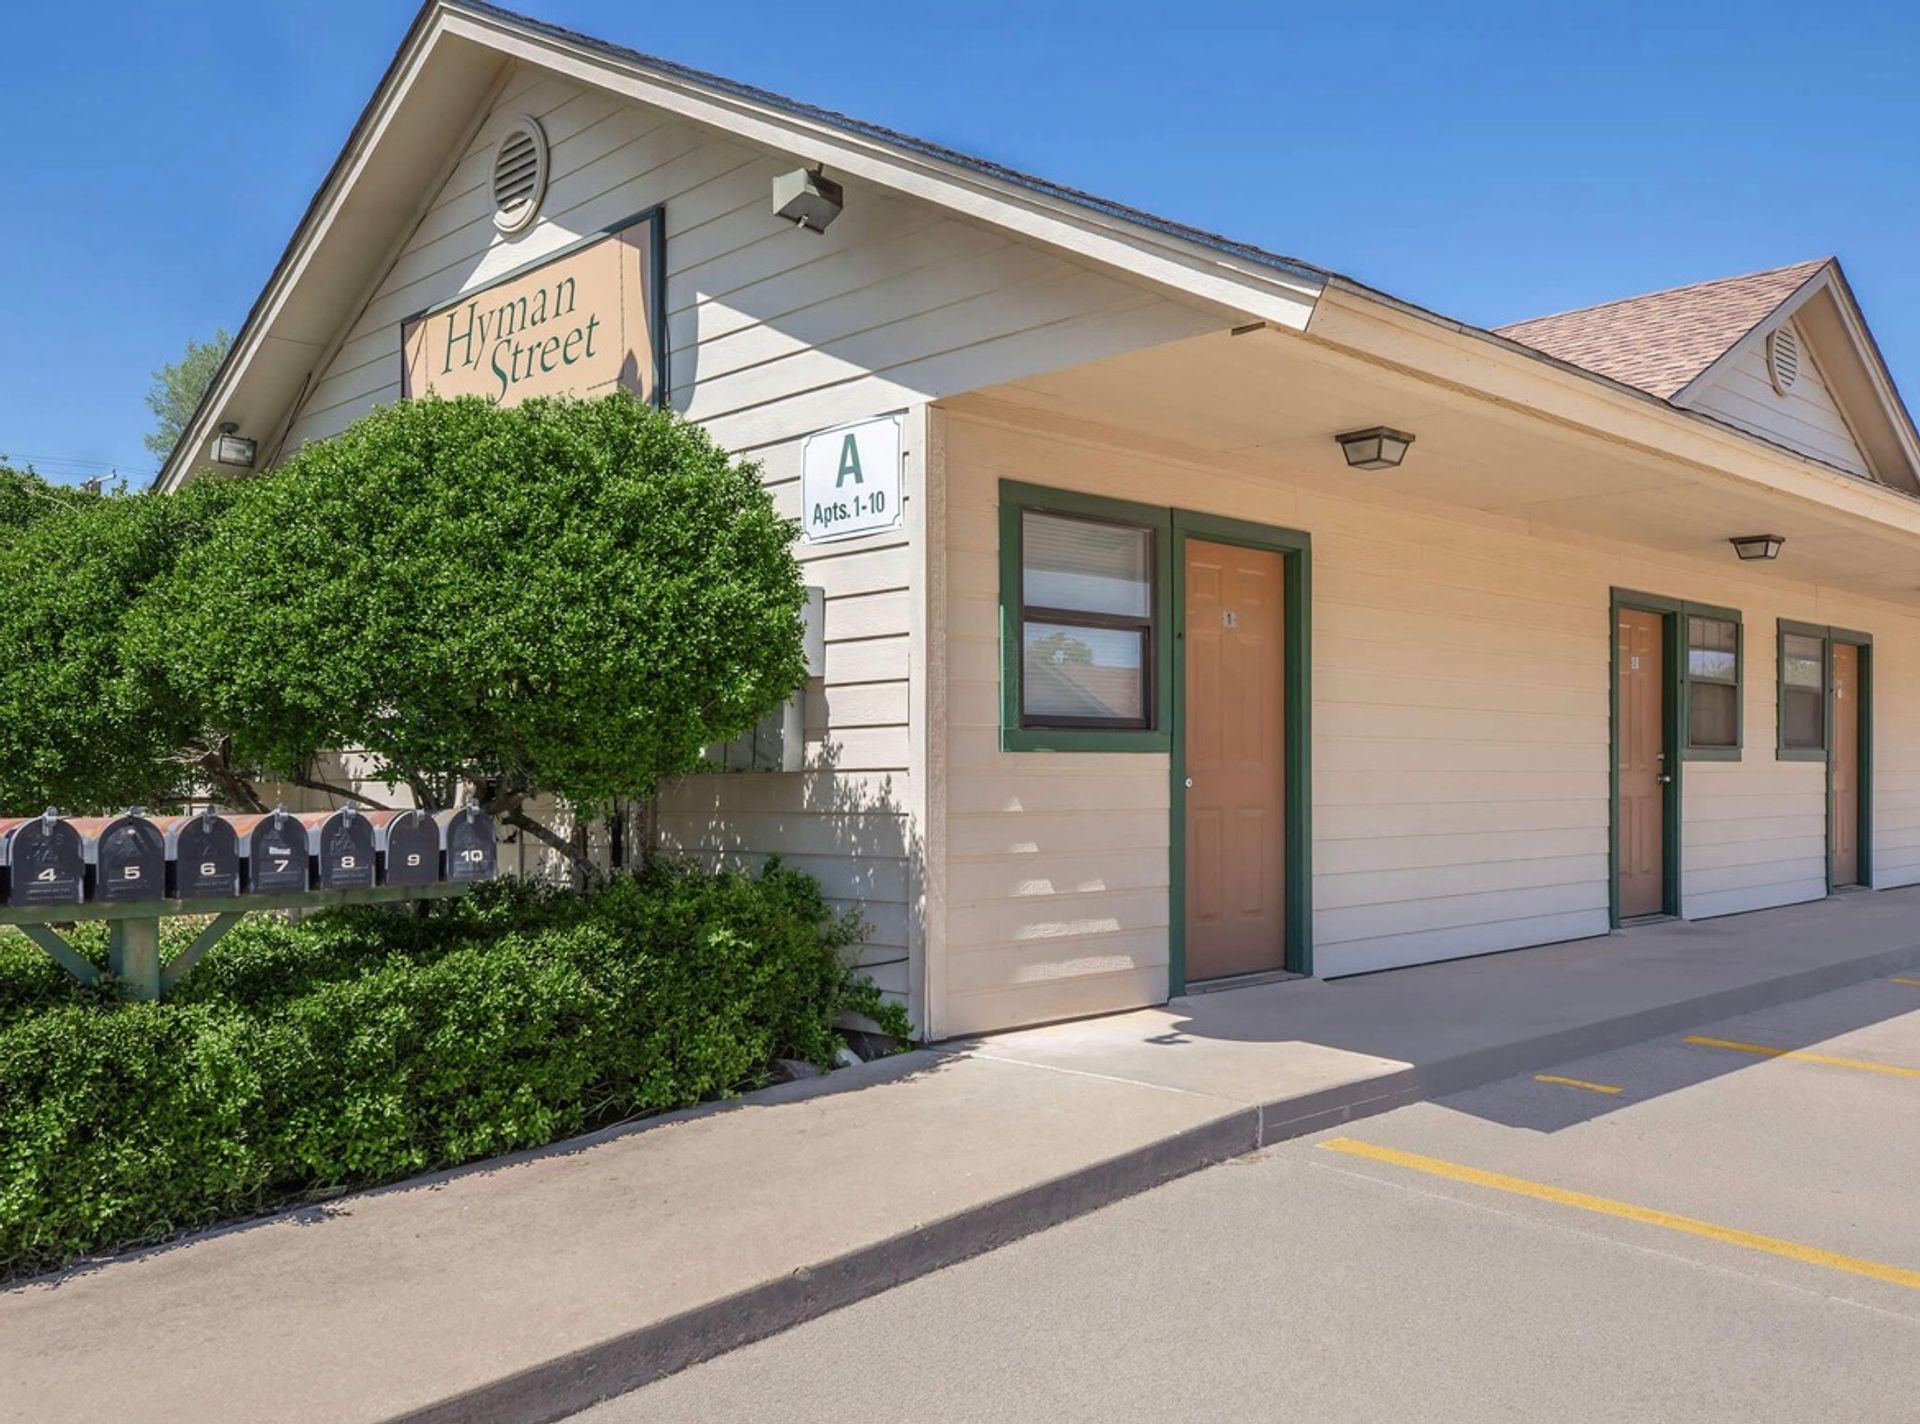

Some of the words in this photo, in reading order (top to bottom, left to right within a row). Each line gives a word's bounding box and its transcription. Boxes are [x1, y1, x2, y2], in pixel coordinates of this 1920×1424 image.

[441, 276, 576, 375] Hyman
[490, 312, 600, 402] Street
[835, 433, 864, 488] A
[812, 502, 851, 528] Apts.
[853, 490, 885, 517] 1-10
[341, 856, 355, 869] 8
[407, 854, 420, 866] 9
[460, 850, 484, 863] 10
[124, 866, 141, 880] 5
[200, 862, 216, 876] 6
[274, 860, 289, 873] 7
[38, 868, 57, 882] 4
